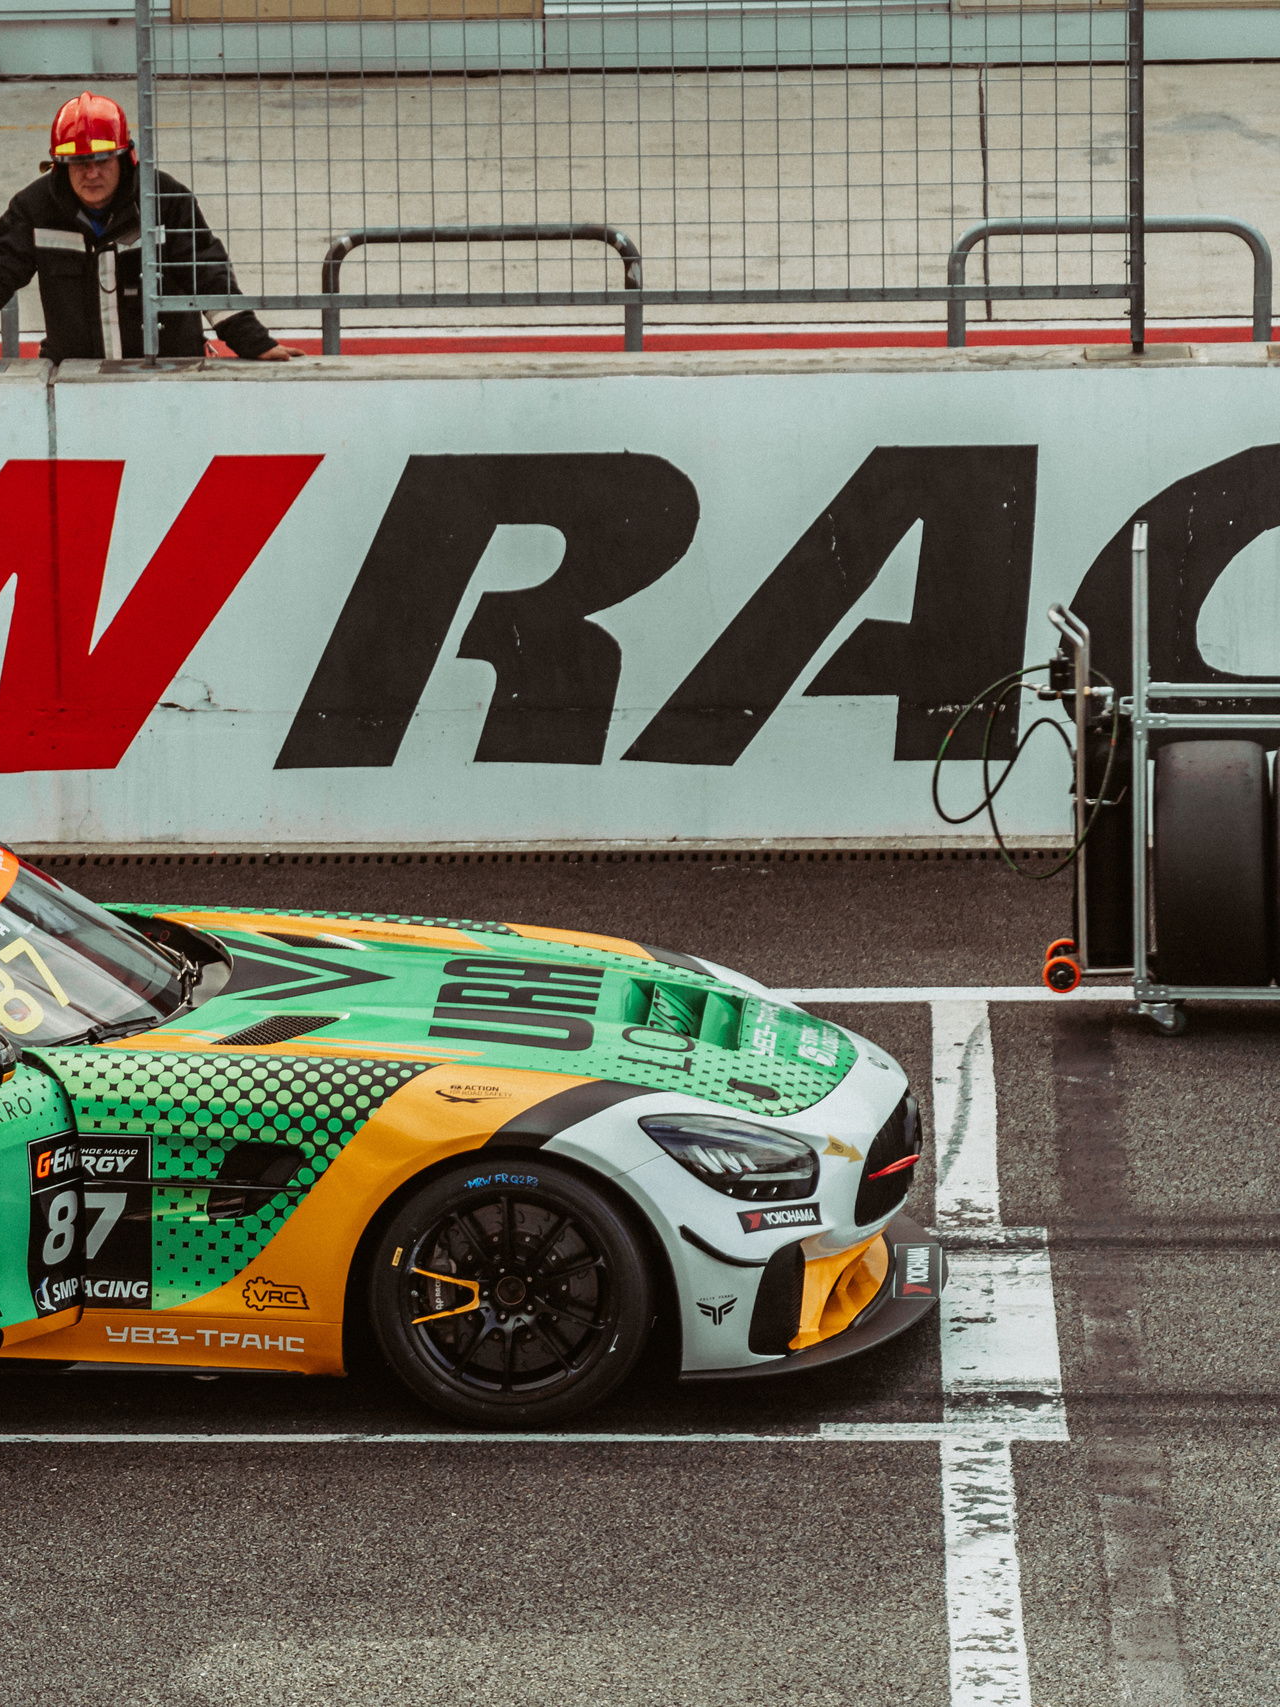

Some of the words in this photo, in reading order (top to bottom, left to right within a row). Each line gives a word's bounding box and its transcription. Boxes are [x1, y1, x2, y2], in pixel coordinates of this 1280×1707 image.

[427, 952, 607, 1051] URA
[42, 1190, 128, 1266] 87
[762, 1208, 817, 1225] YOKOHAMA
[906, 1246, 930, 1284] YOKOHAMA
[52, 1277, 79, 1302] SMP
[81, 1280, 149, 1299] ACING
[253, 1289, 299, 1304] VRC
[105, 1325, 305, 1353] УВЗ-ТРАНС
